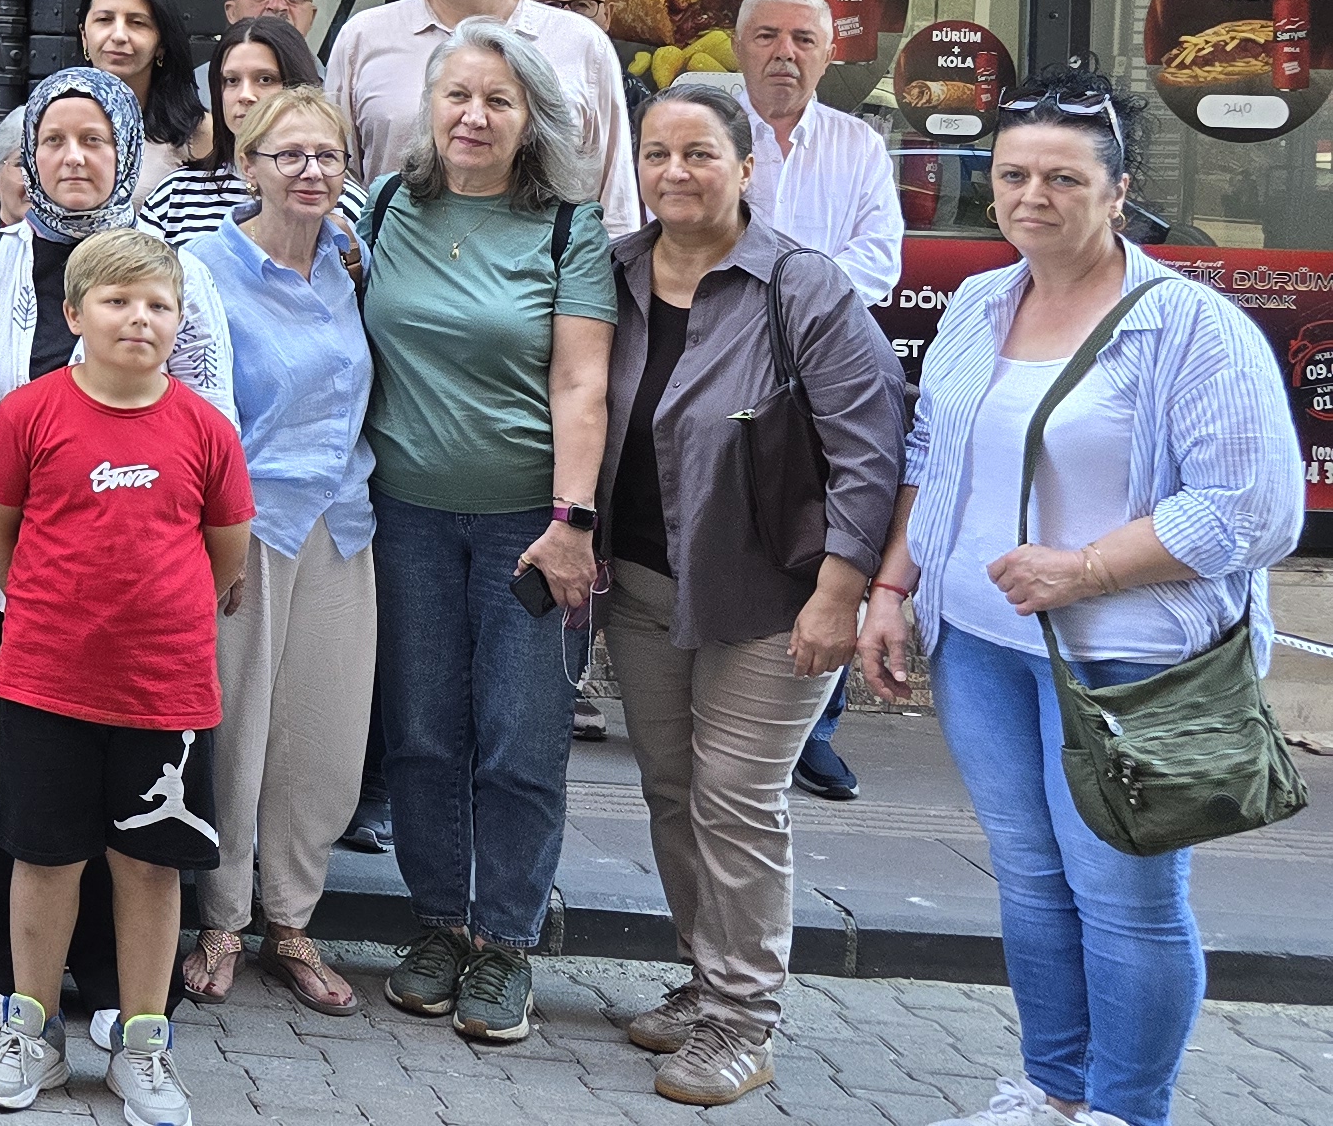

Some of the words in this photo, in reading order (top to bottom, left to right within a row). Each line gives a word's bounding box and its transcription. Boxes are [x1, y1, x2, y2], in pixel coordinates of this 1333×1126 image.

[932, 27, 982, 43] DÜRÜM
[937, 55, 974, 69] KOLA
[1223, 102, 1253, 118] 240
[1306, 363, 1333, 380] 09.
